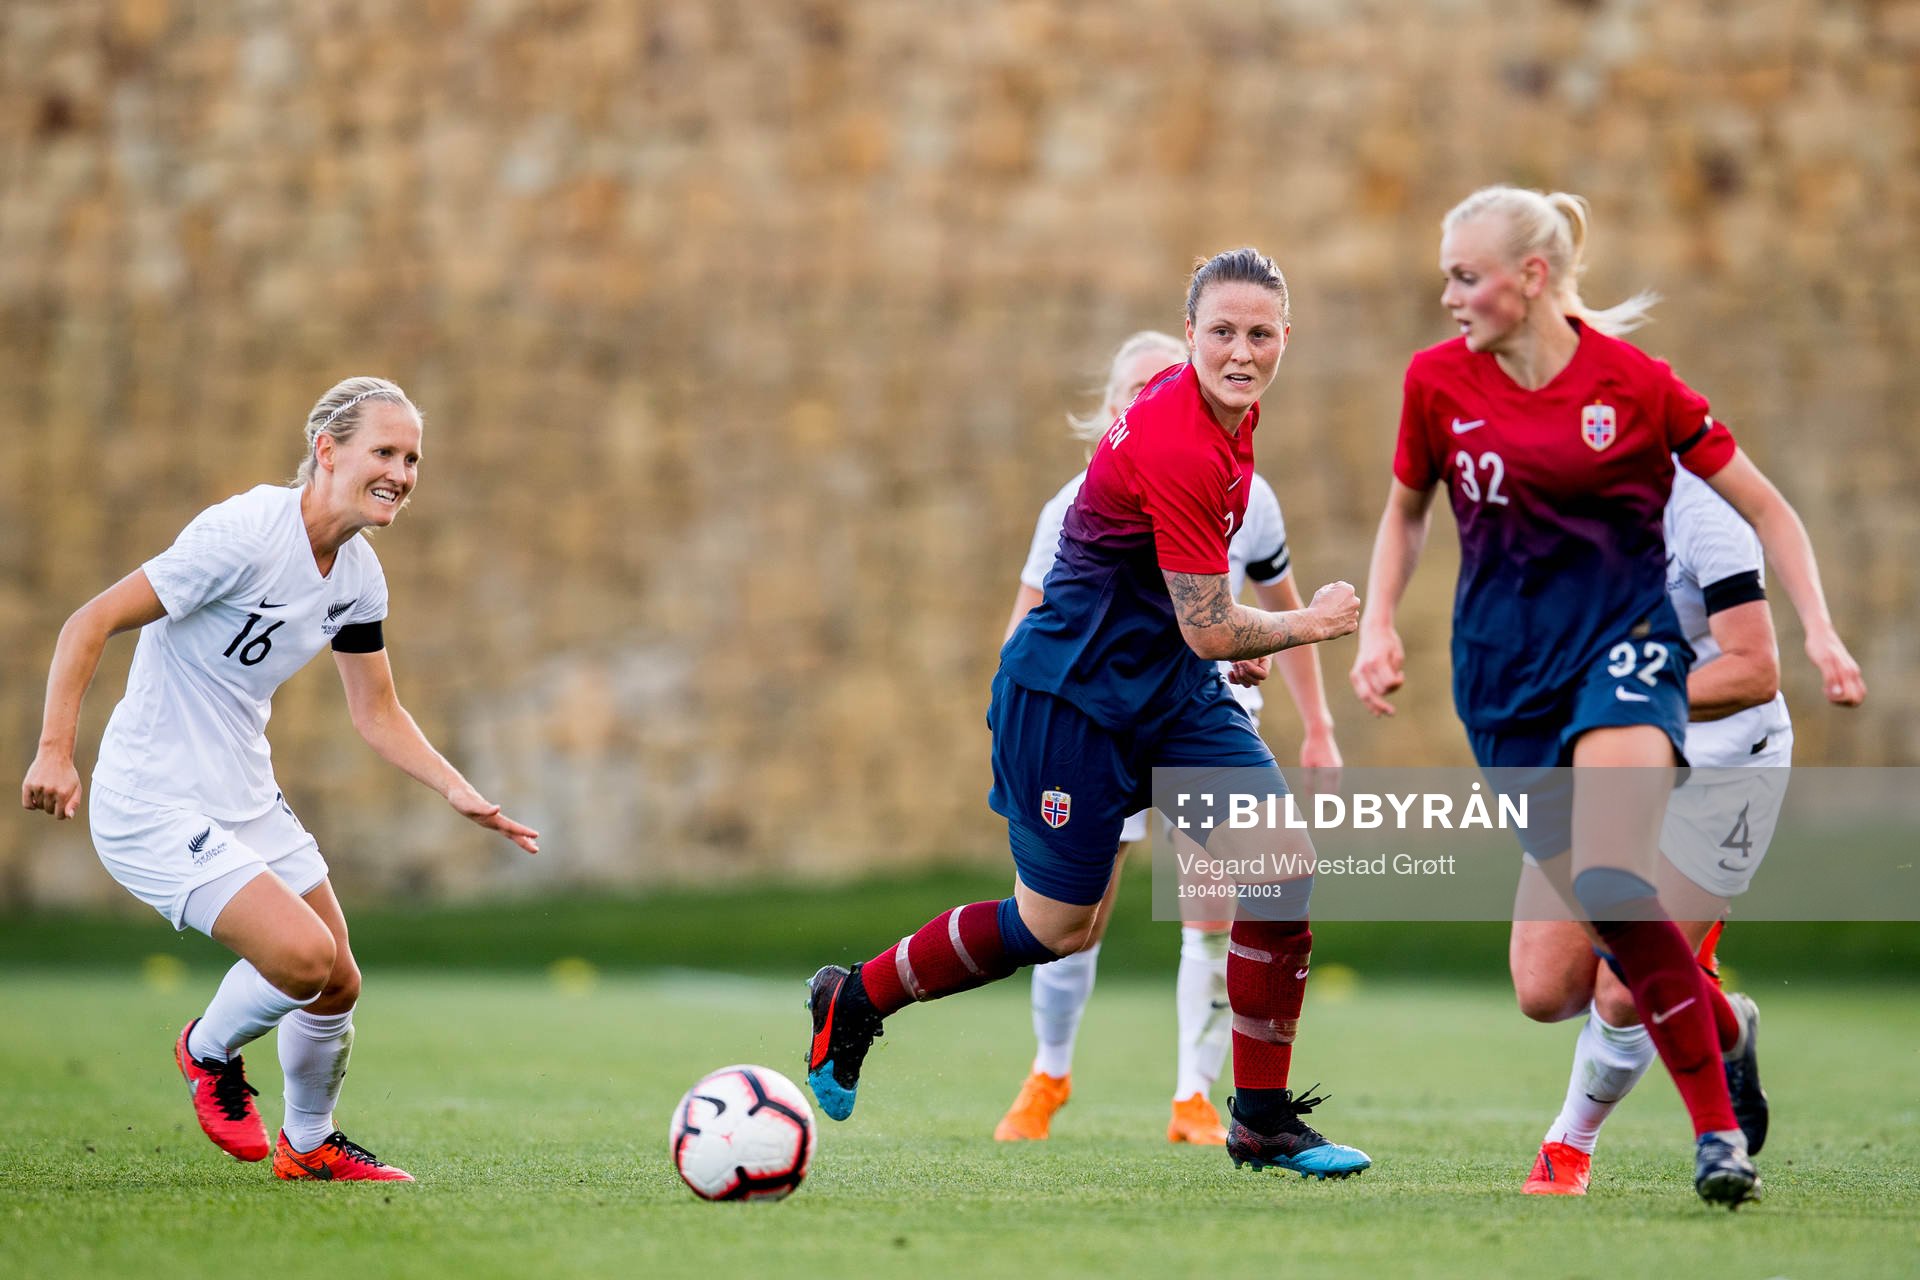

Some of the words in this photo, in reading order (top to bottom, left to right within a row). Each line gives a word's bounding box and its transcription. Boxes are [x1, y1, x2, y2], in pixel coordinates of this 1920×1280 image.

[1455, 450, 1508, 504] 32
[223, 612, 285, 666] 16
[1719, 799, 1753, 858] 4
